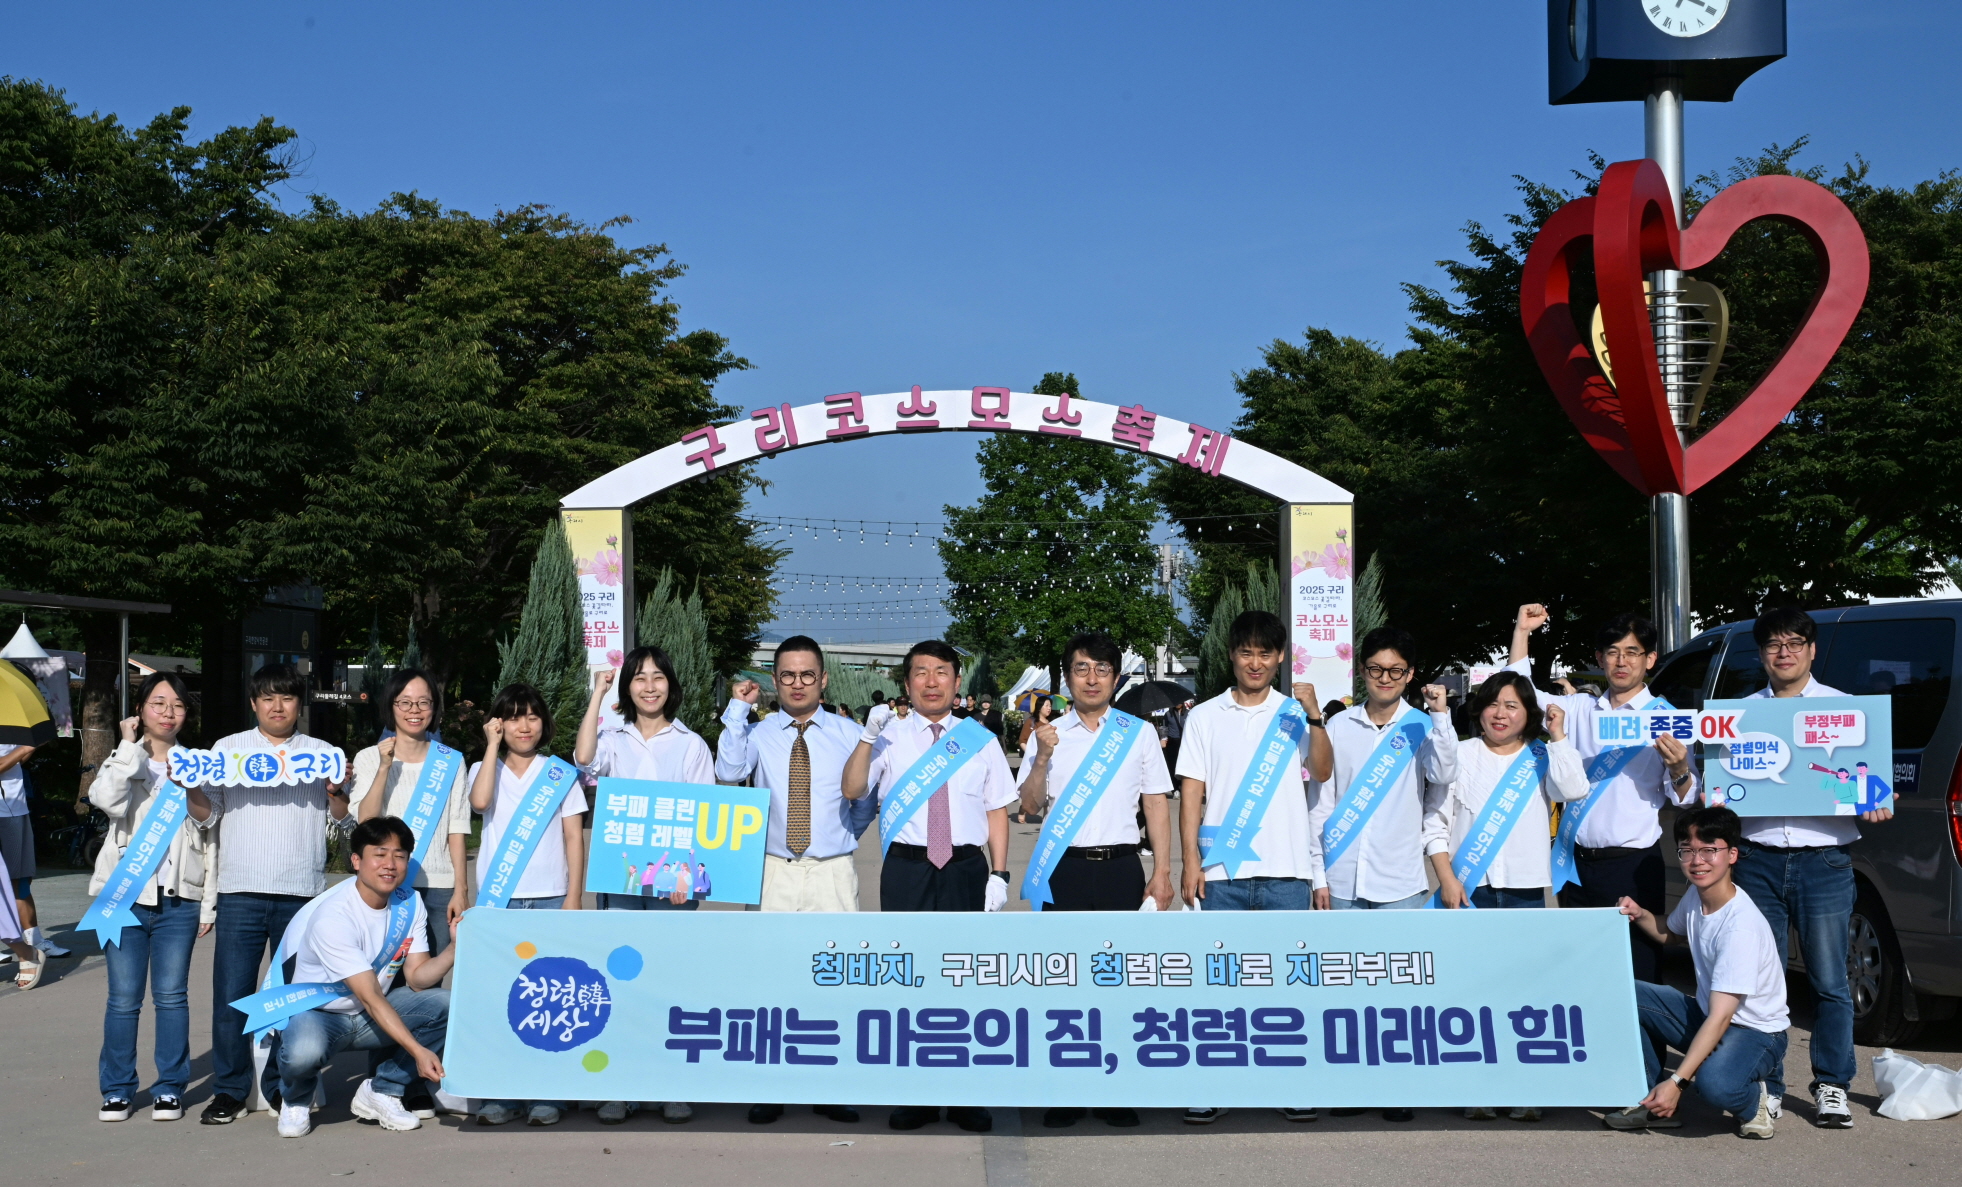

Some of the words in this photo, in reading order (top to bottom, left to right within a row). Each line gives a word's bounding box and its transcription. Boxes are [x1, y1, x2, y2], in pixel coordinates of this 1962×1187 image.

[579, 592, 596, 601] 025
[598, 592, 615, 601] 구리
[1299, 585, 1325, 595] 2025
[1326, 585, 1344, 595] 구리
[582, 620, 620, 634] 스모스
[1295, 614, 1349, 627] 코스모스
[582, 635, 607, 648] 축제
[1308, 628, 1336, 642] 축제
[1274, 718, 1297, 743] 함께
[1701, 715, 1736, 739] OK
[1804, 714, 1855, 729] 부정부패
[1098, 730, 1125, 764] 우리가
[172, 751, 226, 782] 청렴
[290, 752, 341, 779] 구리
[426, 759, 449, 793] 우리가
[916, 754, 948, 786] 우리가
[1084, 759, 1108, 787] 함께
[1247, 740, 1286, 798] 만들어가요
[1366, 753, 1396, 789] 우리가
[1509, 758, 1538, 790] 우리가
[416, 791, 437, 817] 함께
[527, 784, 555, 818] 우리가
[898, 780, 922, 807] 함께
[1350, 785, 1376, 812] 함께
[1496, 787, 1521, 814] 함께
[156, 798, 181, 824] 함께
[606, 793, 649, 819] 부패
[654, 796, 696, 822] 클린
[880, 799, 904, 843] 만들어가
[1051, 782, 1093, 840] 만들어가요
[514, 815, 538, 842] 함께
[603, 820, 645, 846] 청렴
[650, 825, 694, 850] 레벨
[696, 802, 763, 851] UP
[1226, 828, 1242, 849] 구리
[1464, 810, 1507, 867] 만들어가요
[125, 820, 167, 877] 만들어가요
[1556, 847, 1568, 868] 구리
[488, 839, 525, 898] 만들어가요
[1032, 866, 1043, 887] 구리
[1457, 865, 1472, 886] 청렴
[101, 900, 118, 919] 구리
[392, 906, 409, 942] 우리가
[812, 952, 925, 988] 청바지,
[941, 952, 1078, 987] 구리시의
[1091, 952, 1192, 987] 청렴은
[1205, 952, 1274, 987] 바로
[1286, 951, 1435, 987] 지금부터!
[263, 997, 285, 1013] 구리
[517, 1007, 590, 1043] 세상
[664, 1005, 841, 1066] 부패는
[856, 1007, 1029, 1068] 마음의
[1045, 1007, 1118, 1075] 짐,
[1132, 1006, 1308, 1067] 청렴은
[1322, 1005, 1498, 1066] 미래의
[1507, 1004, 1588, 1064] 힘!
